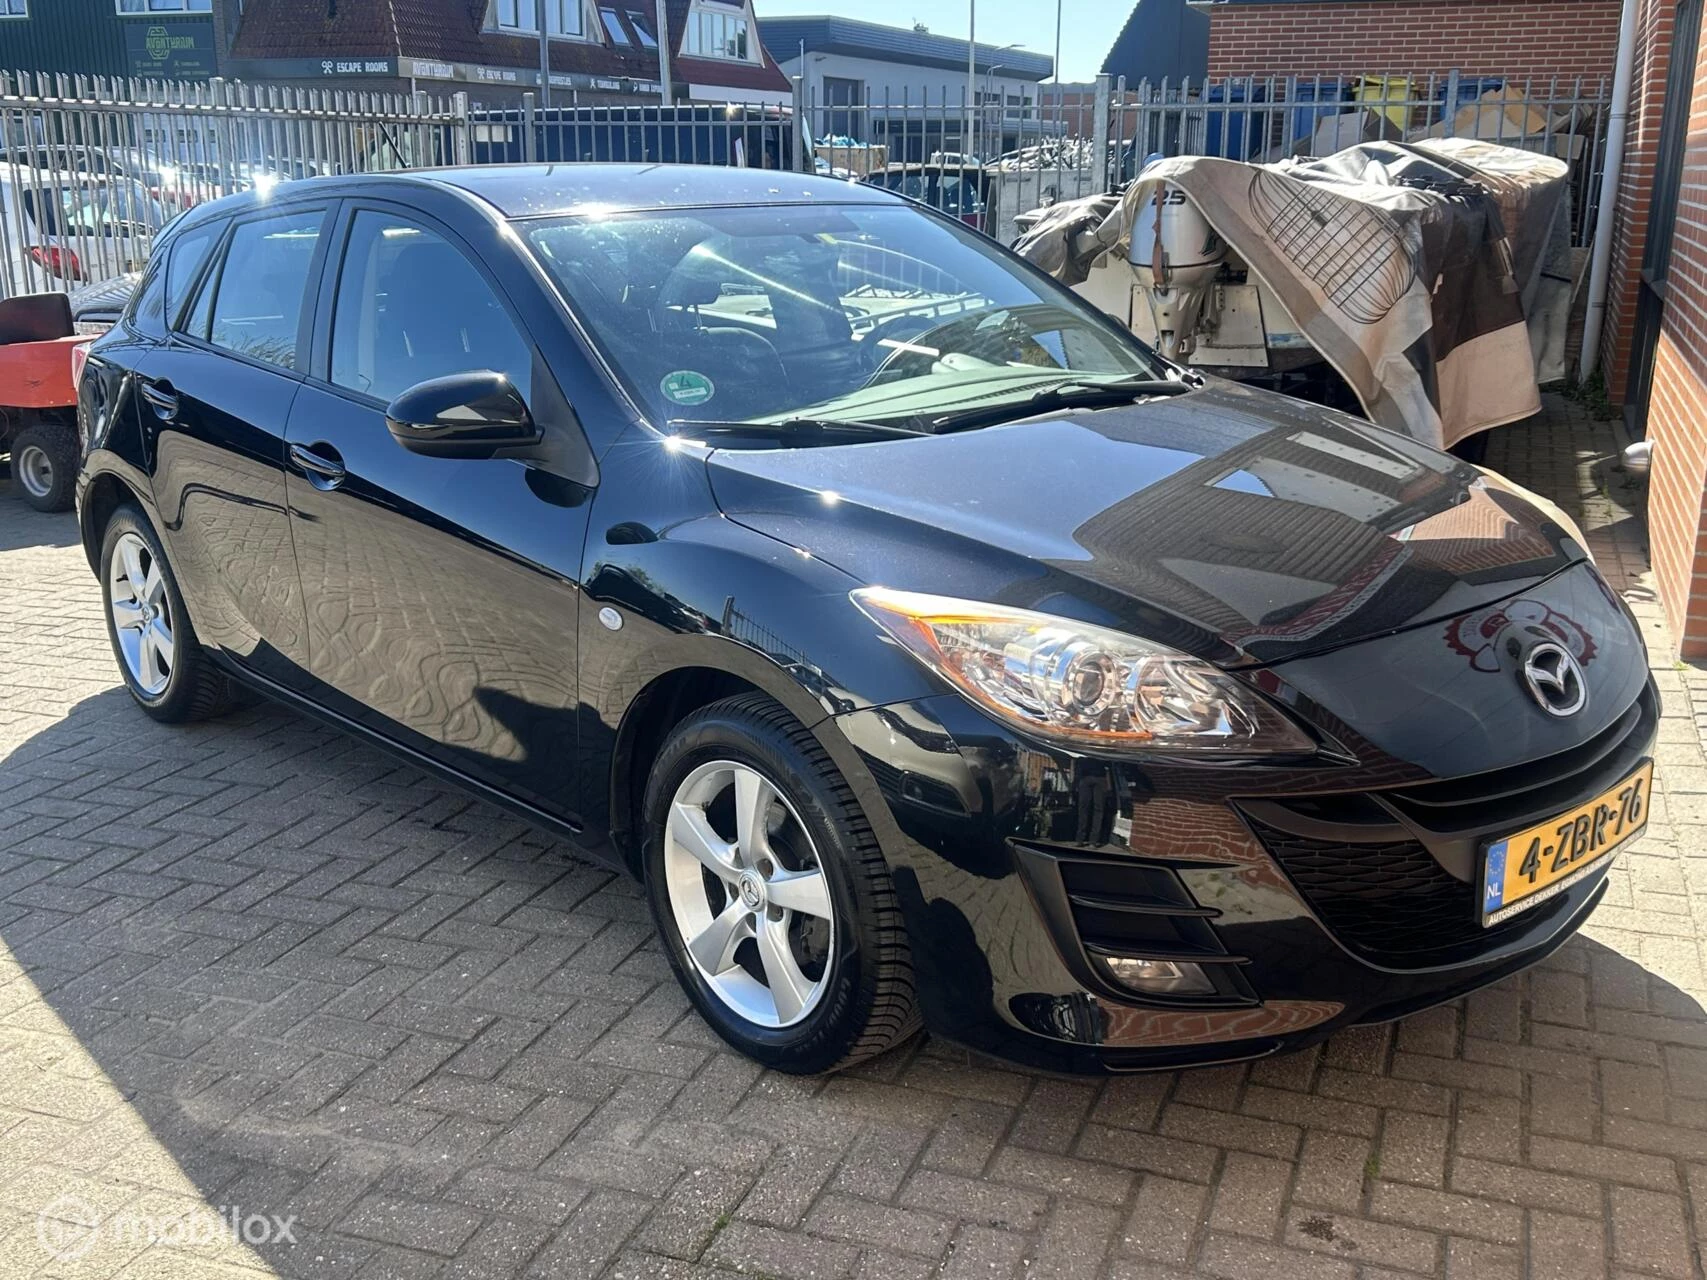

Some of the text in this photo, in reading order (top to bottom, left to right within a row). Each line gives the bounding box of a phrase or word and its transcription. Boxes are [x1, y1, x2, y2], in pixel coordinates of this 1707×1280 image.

[336, 62, 388, 72] ESCAPE ROOMS
[1151, 190, 1186, 206] 25
[1518, 777, 1643, 884] 4-ZBR-76
[1487, 882, 1501, 899] NL
[1488, 898, 1535, 925] AUTOSERVICE
